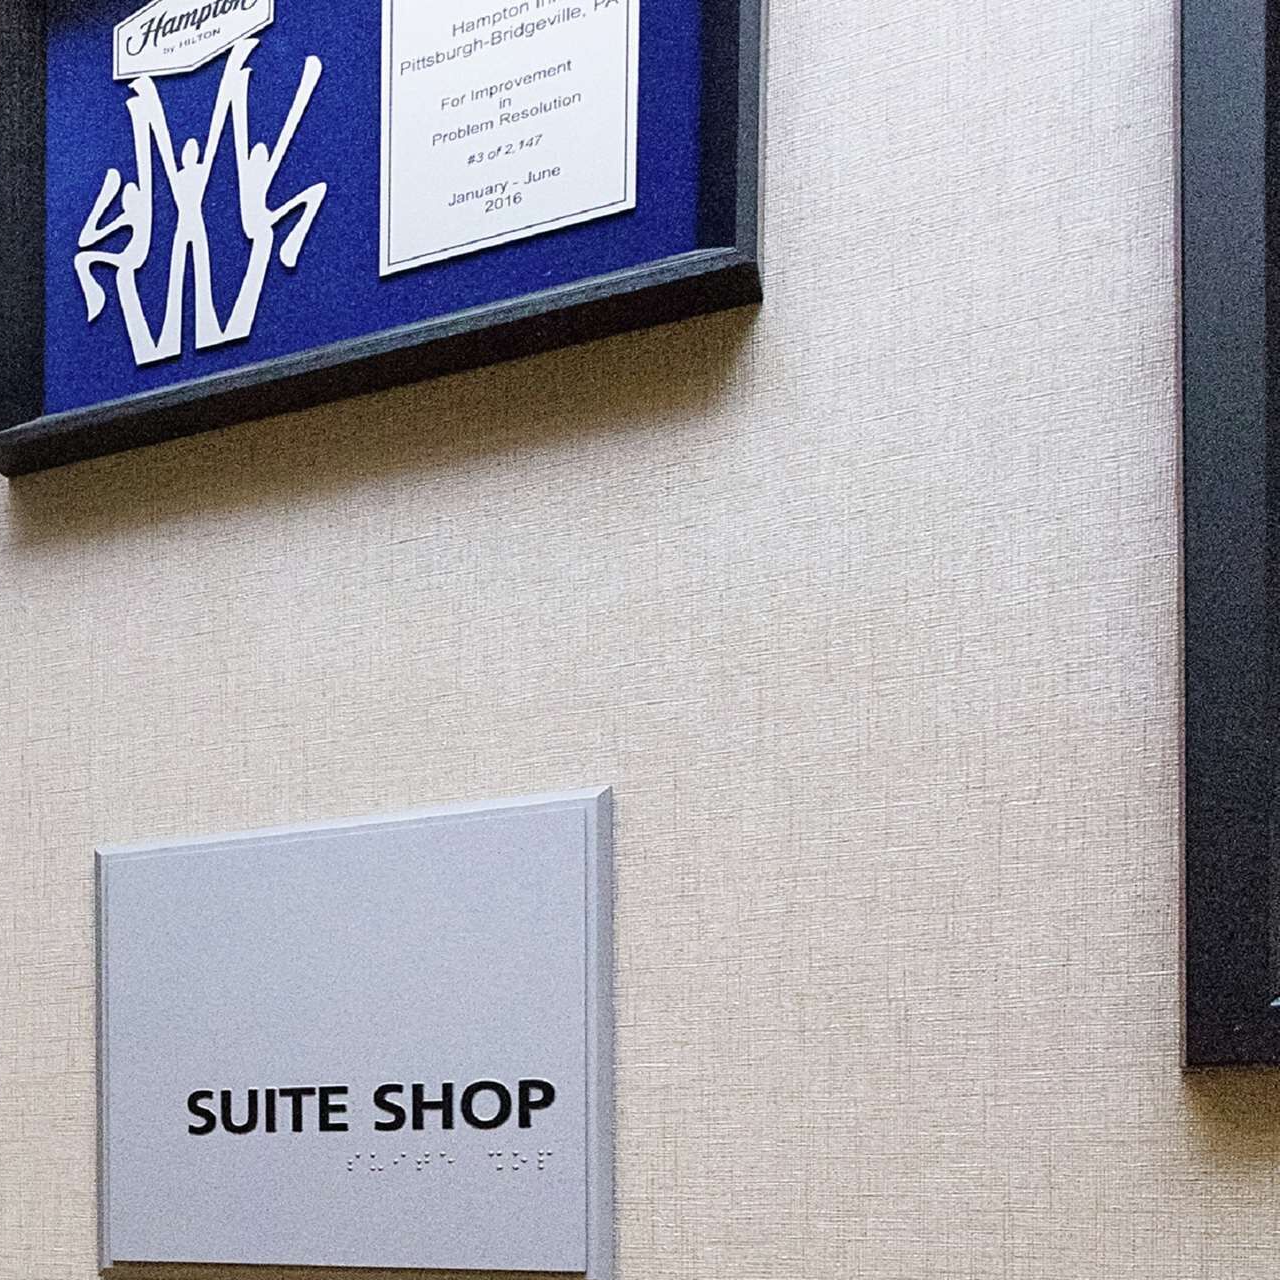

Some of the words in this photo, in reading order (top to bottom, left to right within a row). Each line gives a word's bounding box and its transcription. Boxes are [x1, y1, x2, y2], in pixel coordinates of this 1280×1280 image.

[126, 0, 257, 56] Hampton
[452, 0, 529, 37] Hampton
[441, 93, 465, 111] For
[471, 60, 572, 102] Improvement
[498, 96, 512, 110] in
[432, 120, 494, 147] Problem
[499, 92, 582, 126] Resolution
[448, 181, 508, 207] January
[524, 166, 561, 186] June
[484, 192, 523, 213] 2016
[187, 1085, 349, 1136] SUITE
[372, 1079, 556, 1132] SHOP
